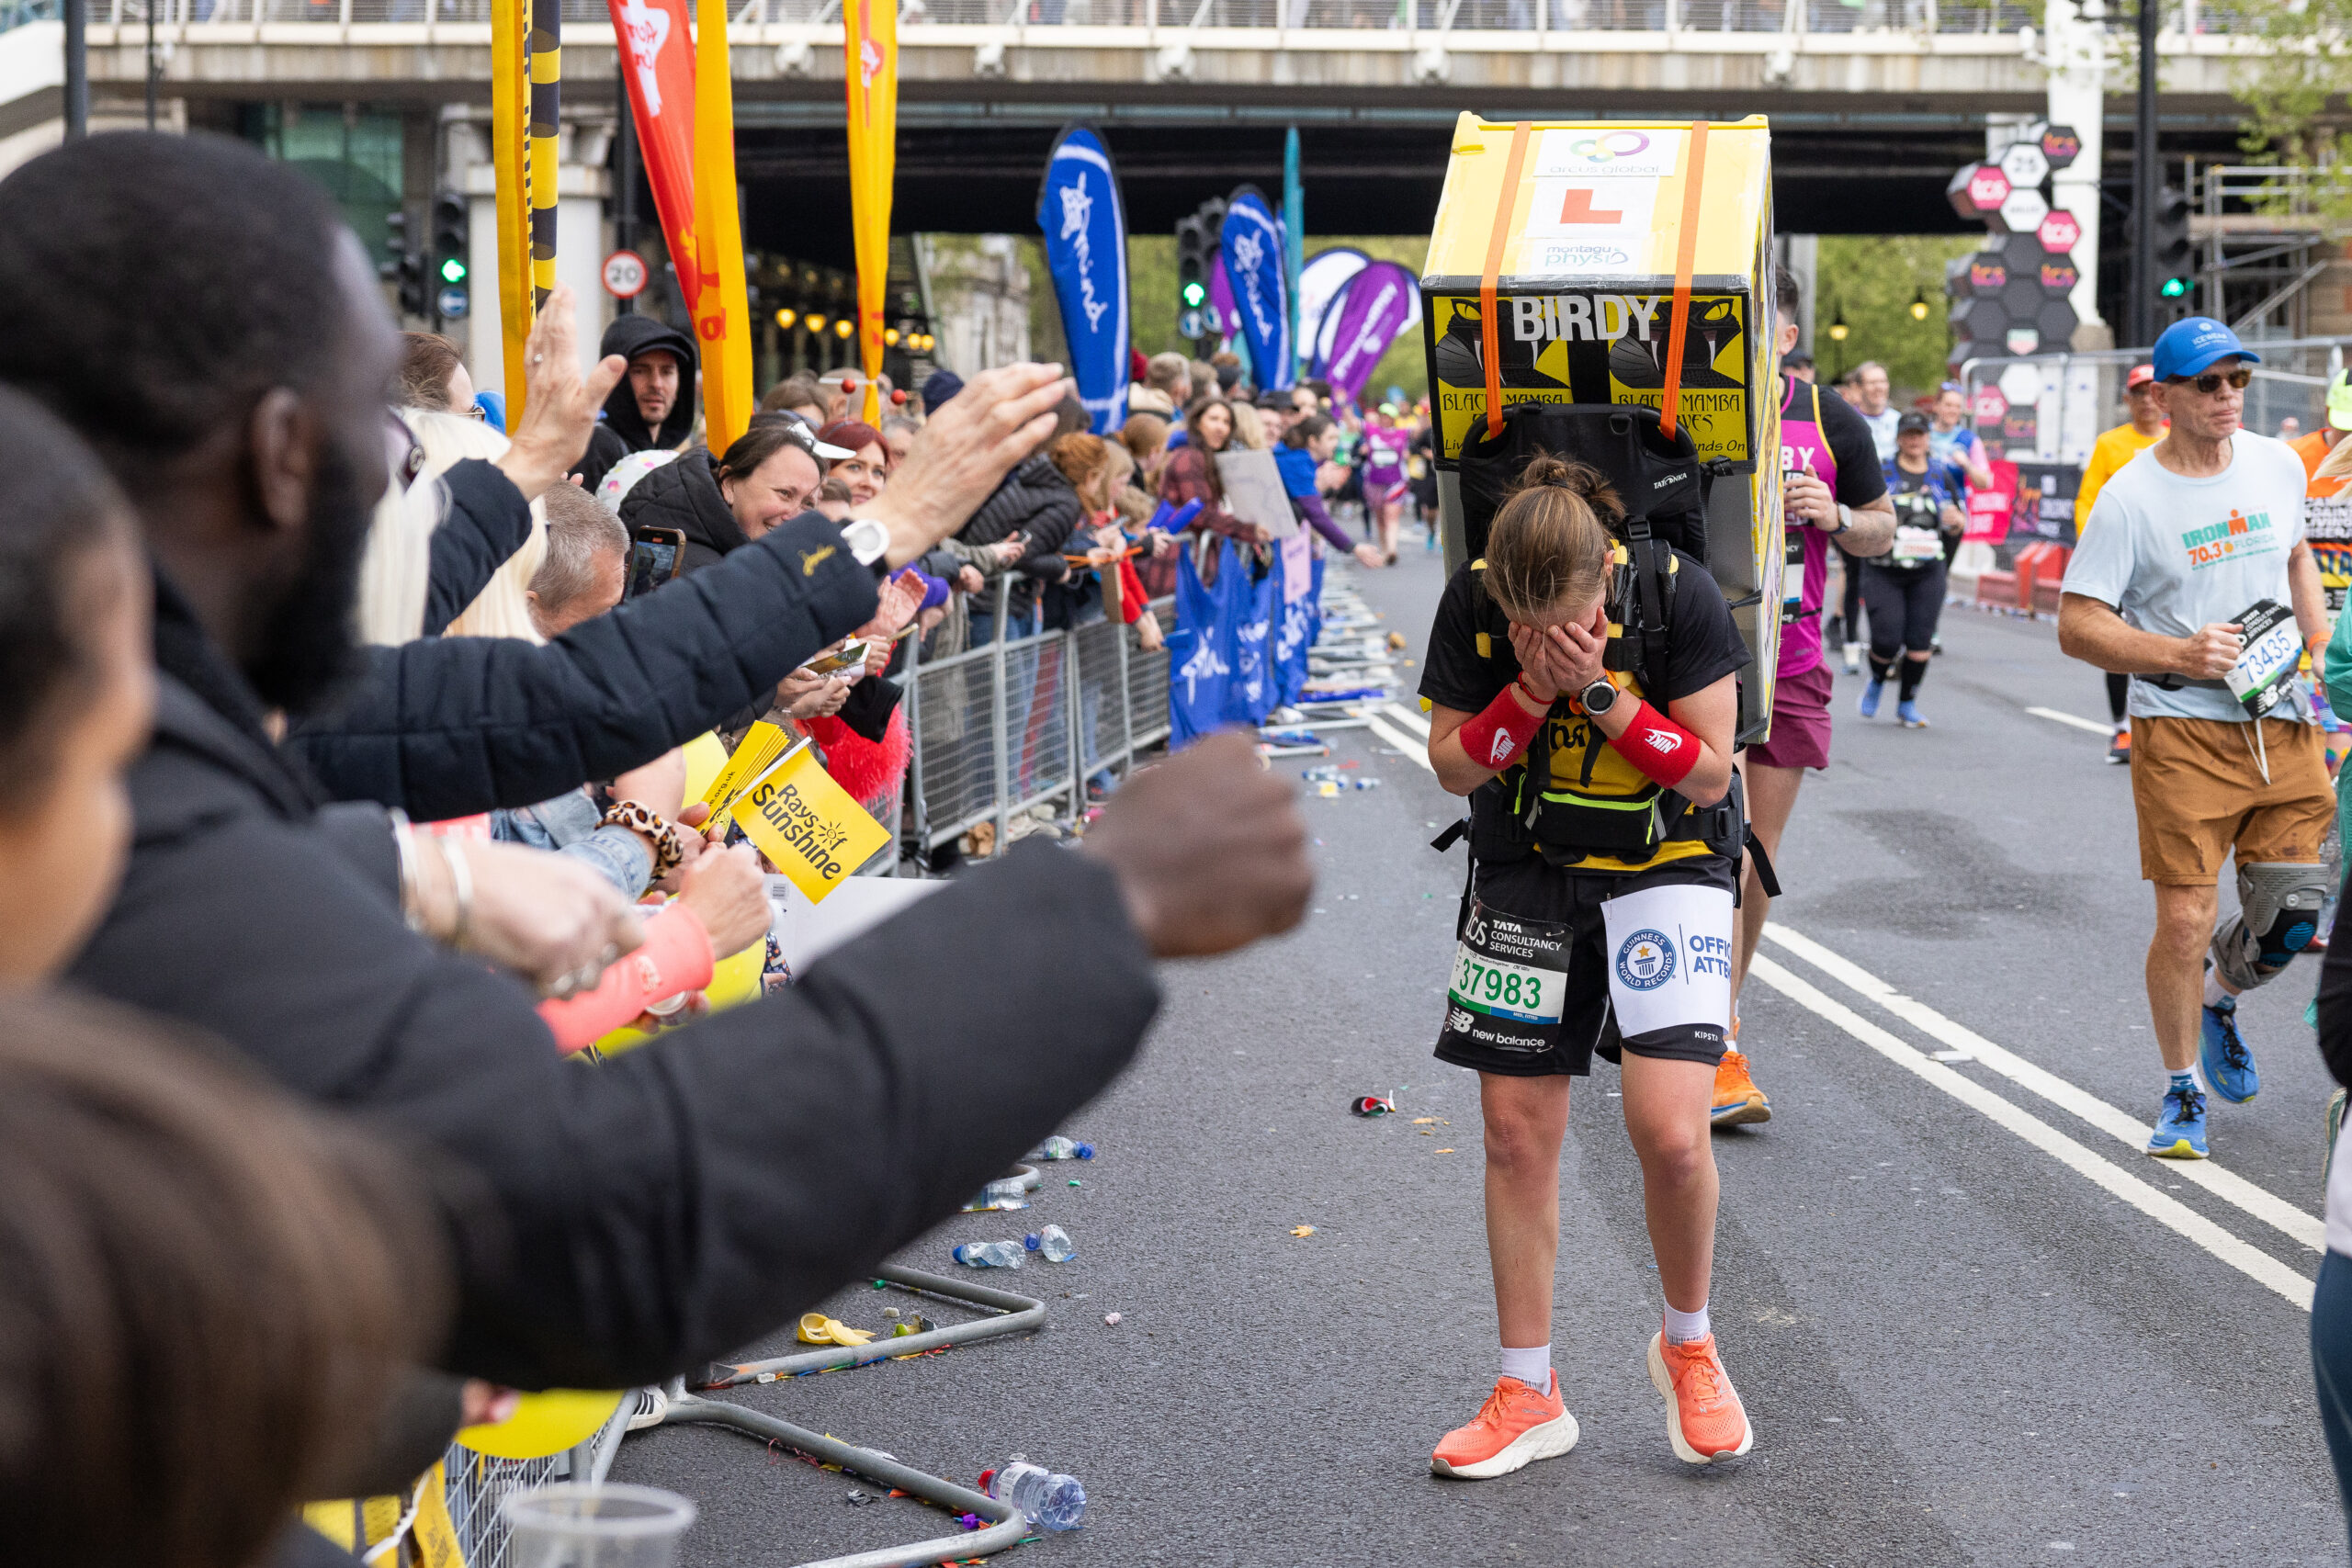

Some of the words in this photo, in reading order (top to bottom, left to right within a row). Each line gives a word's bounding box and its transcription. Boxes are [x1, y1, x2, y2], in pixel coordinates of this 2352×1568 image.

[1601, 165, 1659, 175] global
[1559, 189, 1623, 224] L
[1546, 245, 1611, 254] montagu
[609, 265, 640, 284] 20
[1512, 294, 1661, 342] BIRDY
[1442, 393, 1487, 412] BLAC
[1619, 393, 1663, 408] BLAC
[1682, 393, 1740, 412] MAMBA
[1726, 439, 1746, 452] On
[2182, 509, 2272, 548] IRONMAN
[2188, 542, 2222, 566] 70.3
[2238, 629, 2291, 683] 73435
[1496, 735, 1516, 761] NIKE
[1644, 733, 1677, 754] NIKE
[776, 784, 820, 829] Rays
[752, 783, 842, 881] Sunshine
[1492, 919, 1522, 933] TATA
[1489, 942, 1534, 958] SERVICES
[1490, 931, 1563, 952] CONSULTANCY
[1623, 932, 1666, 954] GUINNESS
[1619, 961, 1642, 987] WORLD
[1644, 951, 1673, 987] RECORDS
[1459, 957, 1542, 1010] 37983
[1472, 1028, 1496, 1042] new
[1496, 1032, 1545, 1047] balance
